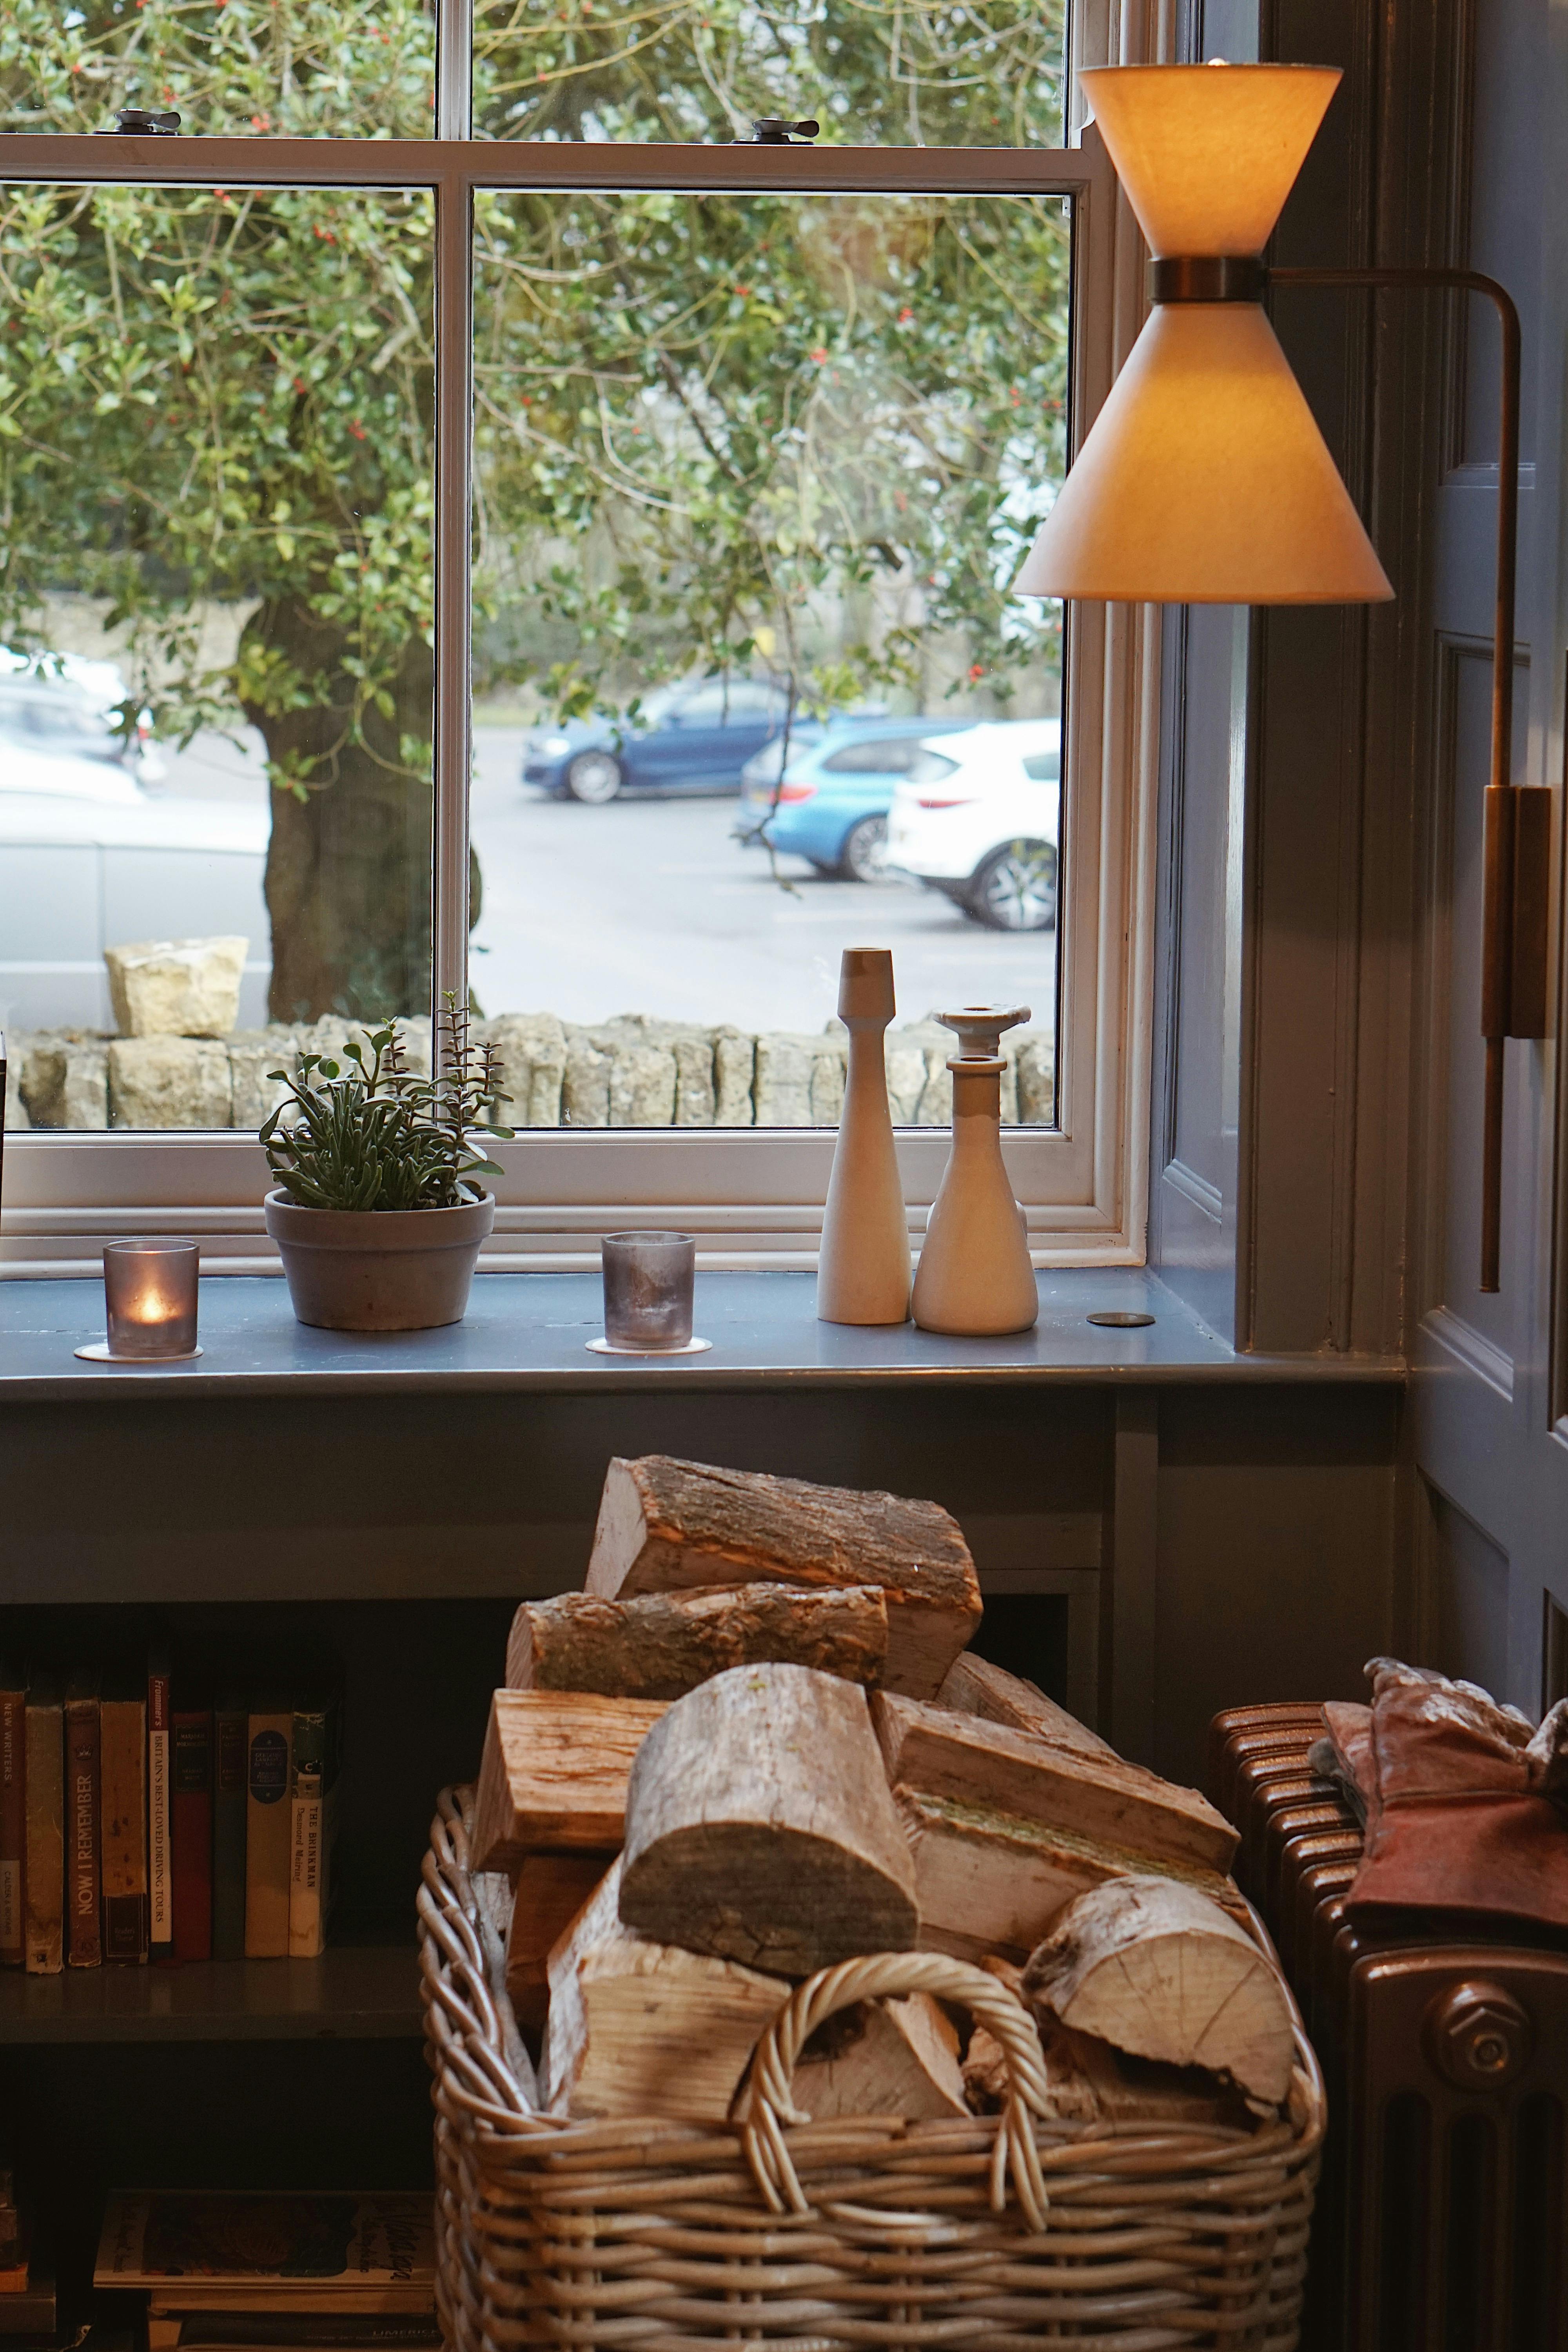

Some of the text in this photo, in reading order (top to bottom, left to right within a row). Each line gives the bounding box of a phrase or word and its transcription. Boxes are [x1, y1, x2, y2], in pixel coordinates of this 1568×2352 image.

[155, 1680, 164, 1727] Frommer's
[78, 1774, 93, 1860] REMEMBER
[307, 1806, 318, 1887] THE BRINKMAN
[78, 1875, 93, 1915] NOW
